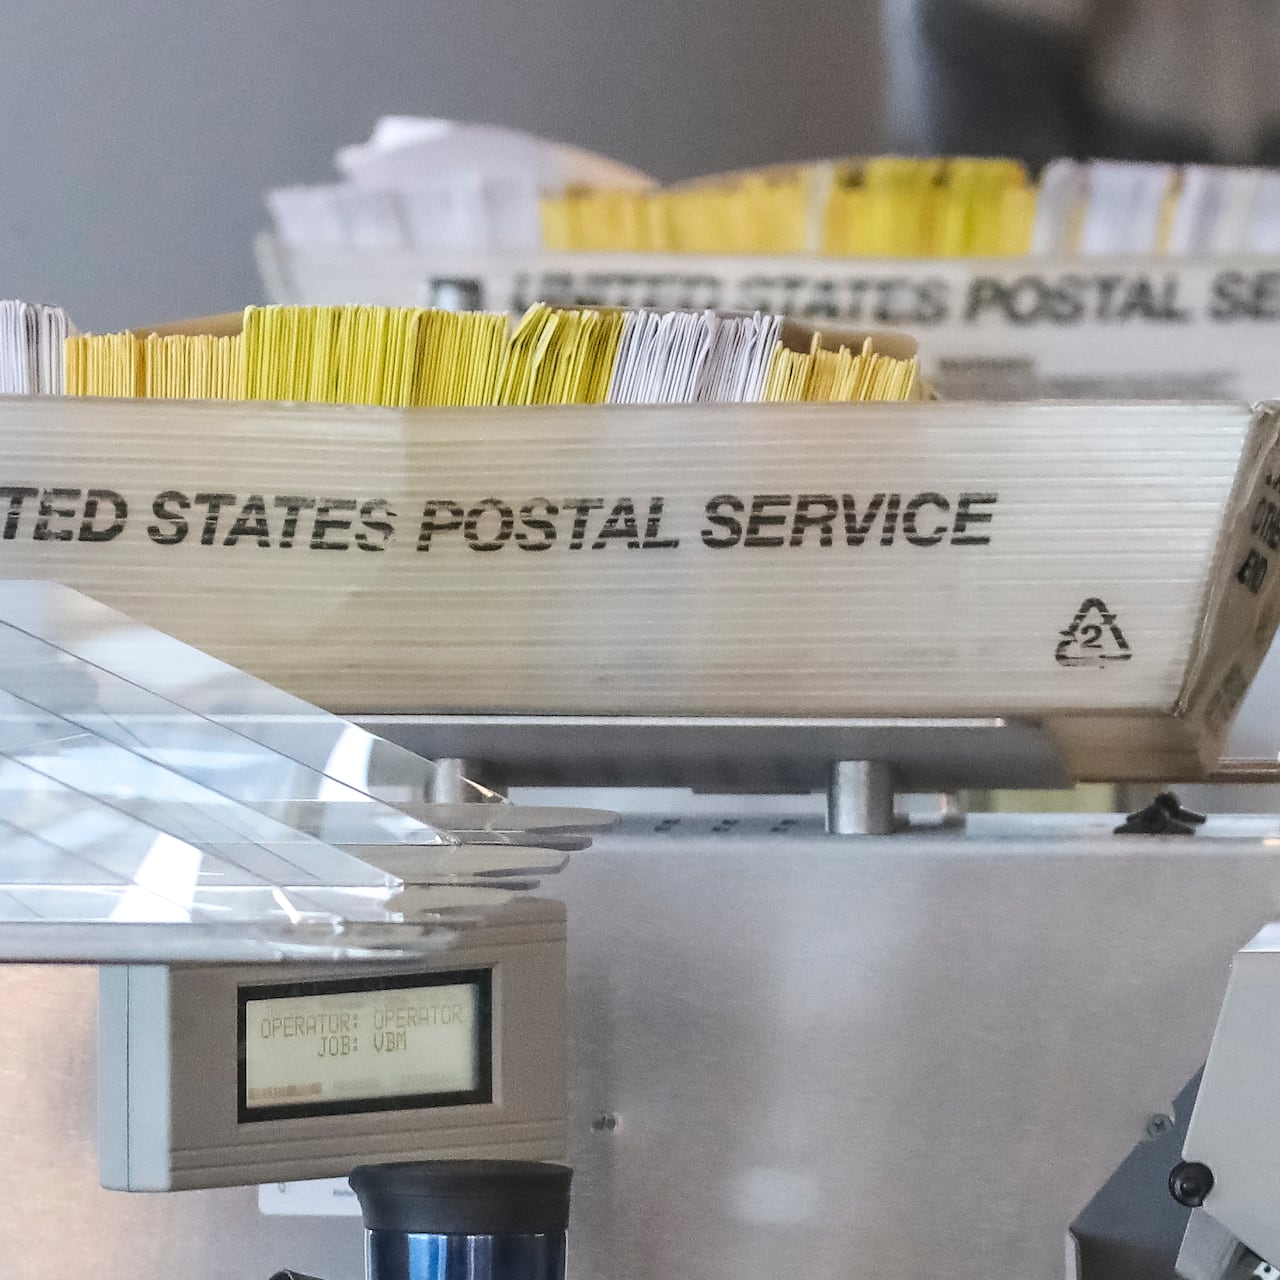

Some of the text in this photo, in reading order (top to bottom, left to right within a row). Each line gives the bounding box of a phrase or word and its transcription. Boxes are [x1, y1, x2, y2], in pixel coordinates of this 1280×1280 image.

[739, 273, 948, 326] STATES
[965, 273, 1191, 327] POSTAL
[147, 490, 398, 551] STATES
[417, 496, 680, 552] POSTAL
[700, 492, 999, 548] SERVICE
[260, 1003, 464, 1040] OPERATOR: OPERATOR
[317, 1030, 408, 1058] JOB: VBM
